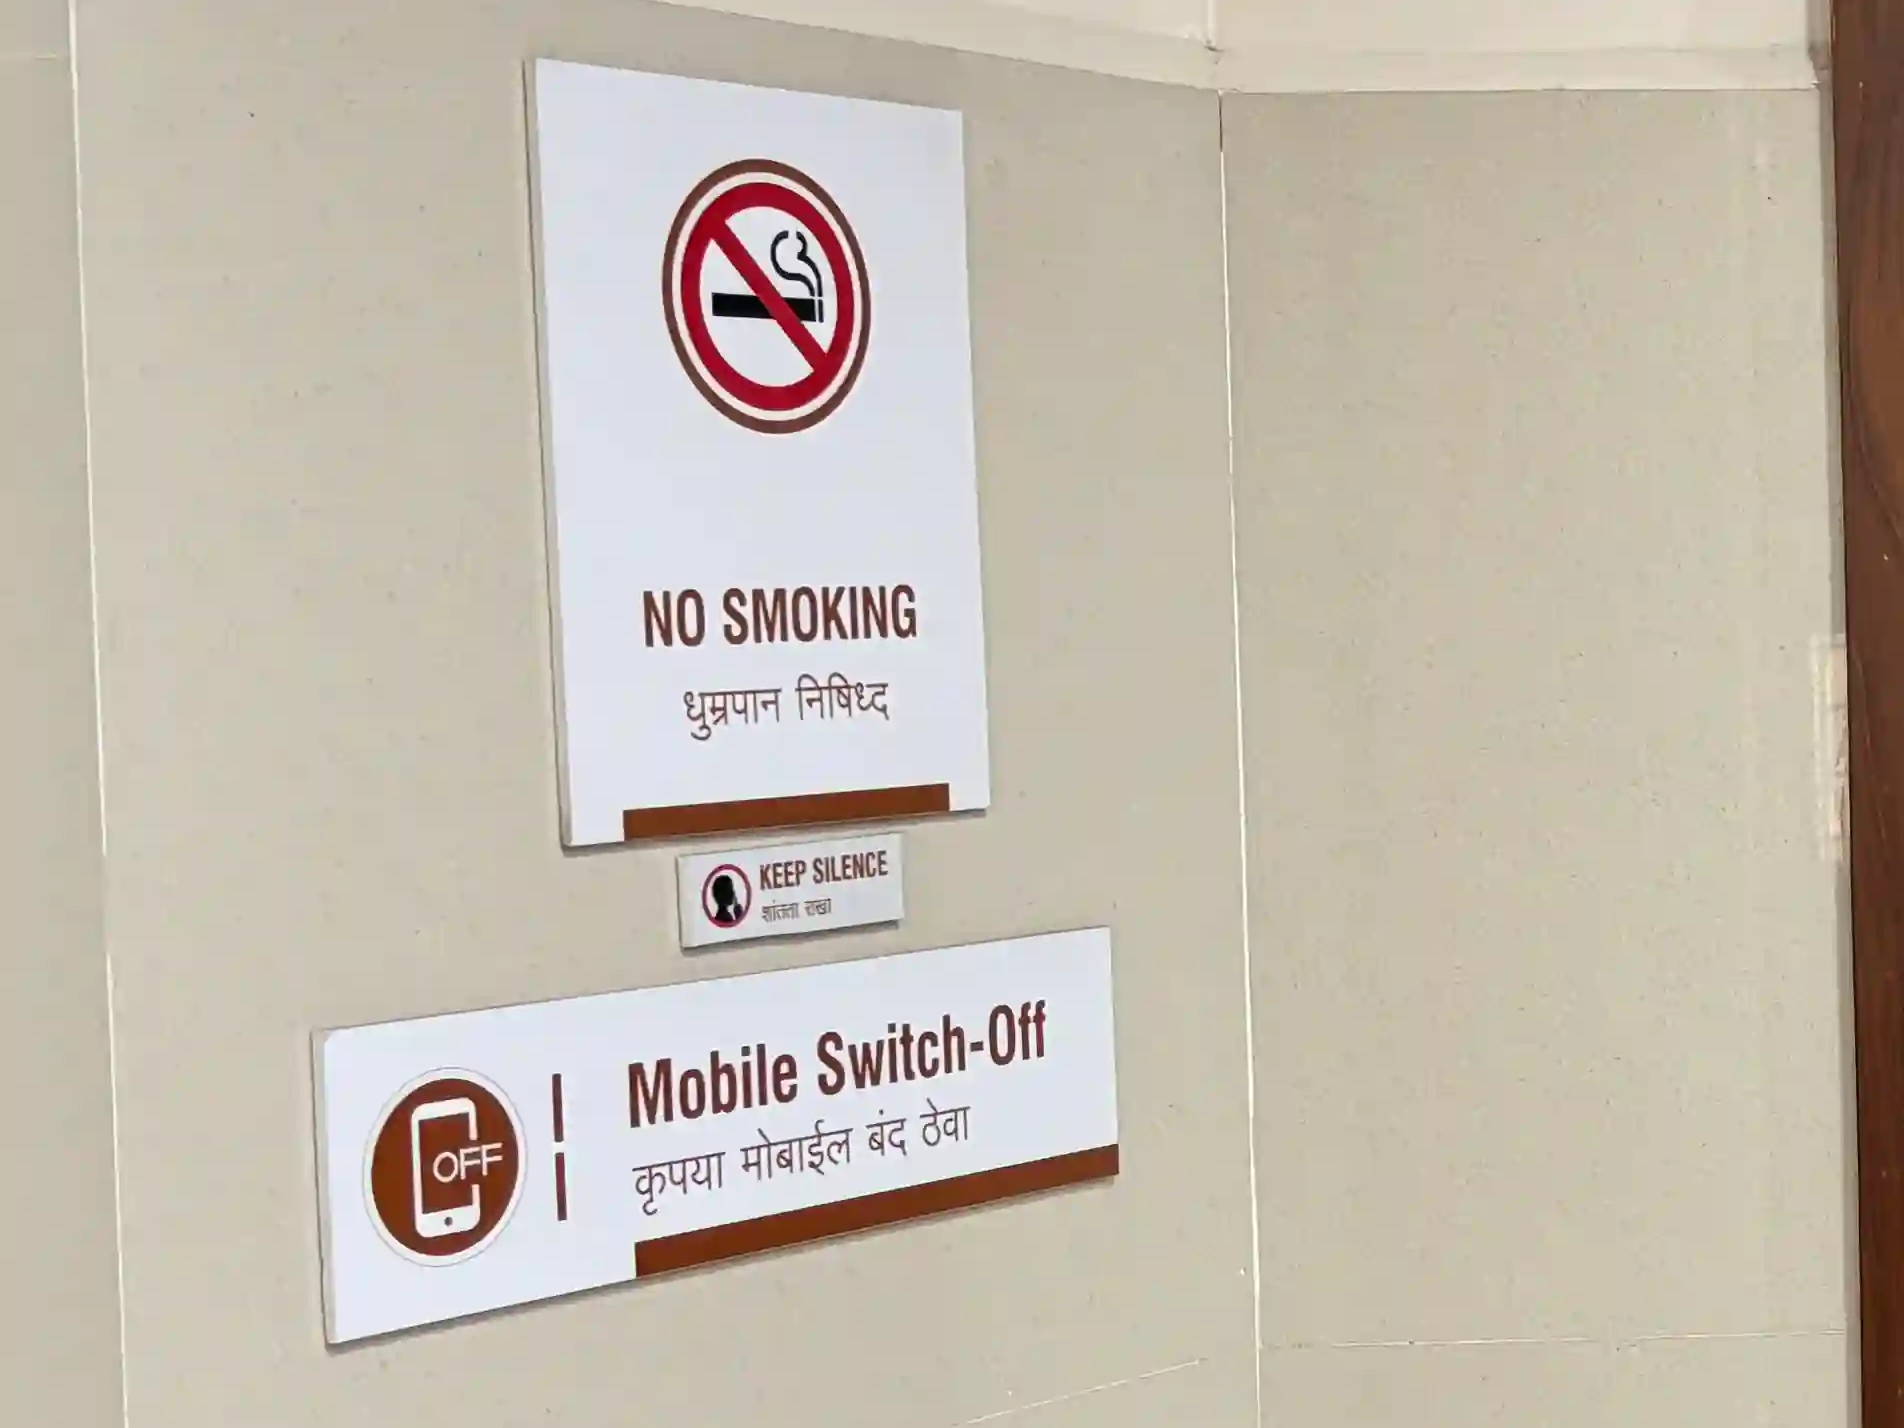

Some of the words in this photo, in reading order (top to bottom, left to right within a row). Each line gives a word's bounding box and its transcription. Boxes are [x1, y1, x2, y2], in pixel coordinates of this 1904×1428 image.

[643, 589, 706, 648] NO
[723, 584, 918, 645] SMOKING
[683, 687, 782, 741] धुम्रपान
[759, 859, 807, 890] KEEP
[812, 850, 889, 884] SILENCE
[628, 1044, 798, 1128] Mobile
[816, 999, 1047, 1096] Switch-Off
[432, 1141, 504, 1184] OFF
[632, 1151, 726, 1216] कृपया
[740, 1119, 854, 1181] मोबाईल
[866, 1110, 907, 1157] बंद
[920, 1097, 971, 1147] ठेवा
